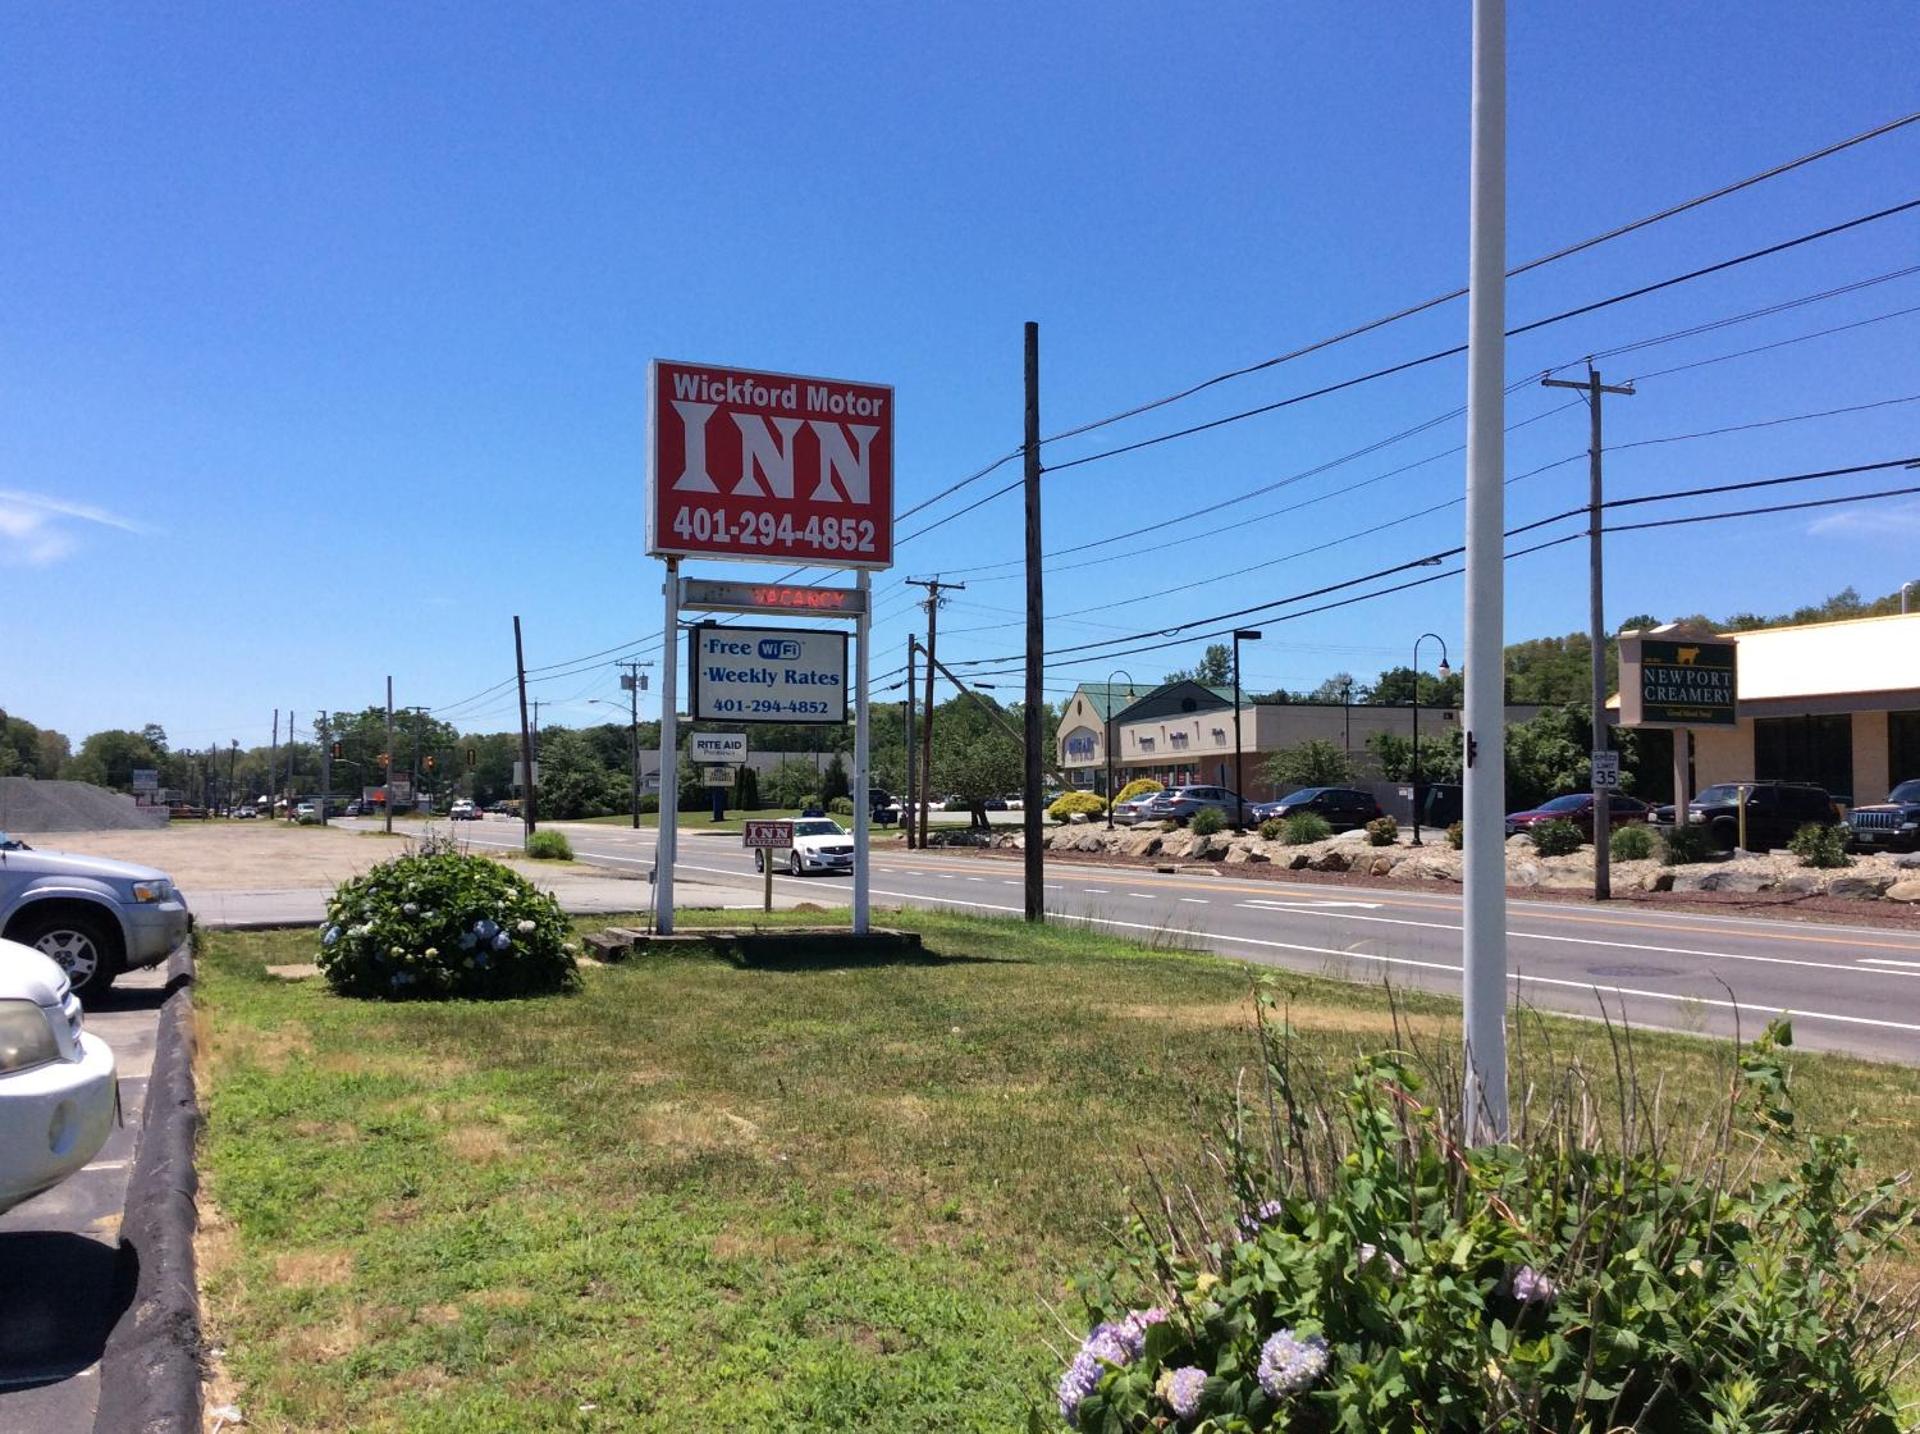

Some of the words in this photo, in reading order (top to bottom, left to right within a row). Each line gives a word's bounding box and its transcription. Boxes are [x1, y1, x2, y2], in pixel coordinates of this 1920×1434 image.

[673, 373, 797, 409] Wickford
[807, 386, 884, 417] Motor
[670, 400, 880, 504] INN
[673, 506, 875, 553] 401-294-4852
[754, 587, 846, 609] VACANCY
[708, 639, 752, 655] Free
[708, 667, 778, 687] Weekly
[785, 670, 840, 686] Rates
[1644, 668, 1732, 686] NEWPORT
[1644, 686, 1732, 704] CREAMERY
[713, 699, 828, 714] 401-294-4852
[697, 740, 721, 750] RITE
[723, 740, 742, 750] AID
[1595, 770, 1617, 785] 35
